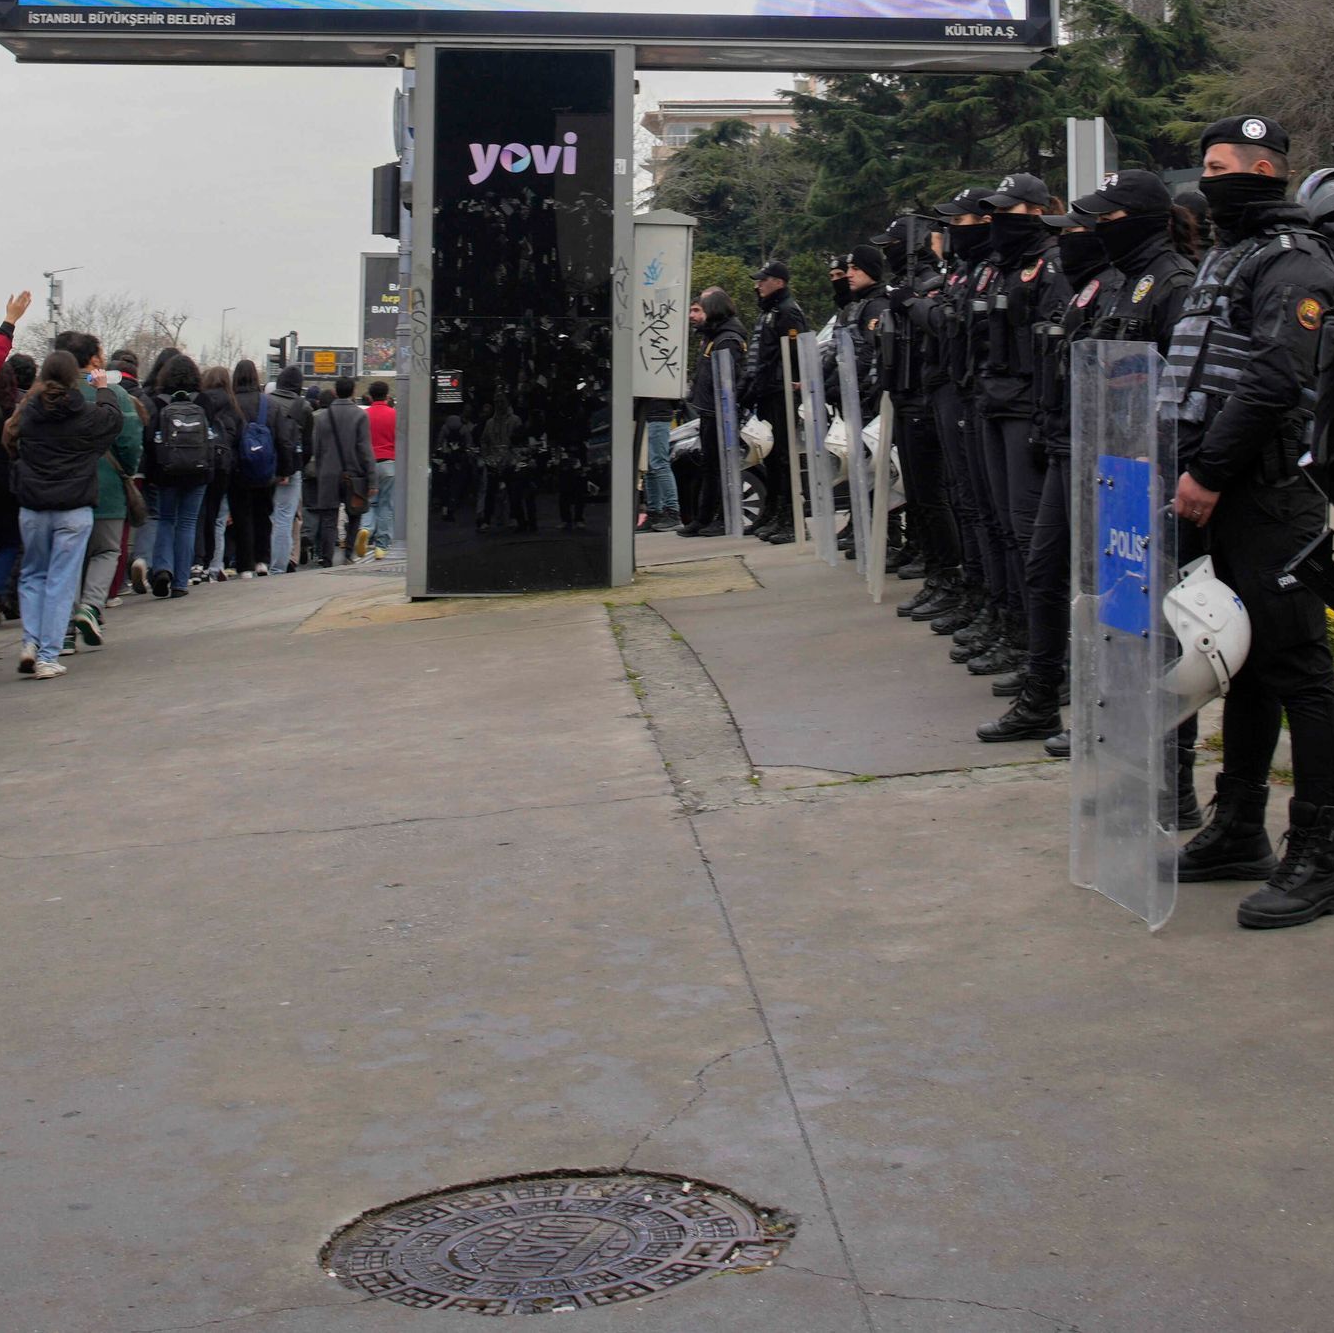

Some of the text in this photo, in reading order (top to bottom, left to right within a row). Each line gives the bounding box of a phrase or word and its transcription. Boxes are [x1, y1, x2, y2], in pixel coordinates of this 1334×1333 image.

[28, 10, 236, 27] İSTANBUL BÜYÜKŞEHİR BELEDİYESİ
[945, 23, 1019, 40] KÜLTÜR A.Ş.
[468, 131, 578, 186] yovi
[1110, 526, 1146, 563] POLİS
